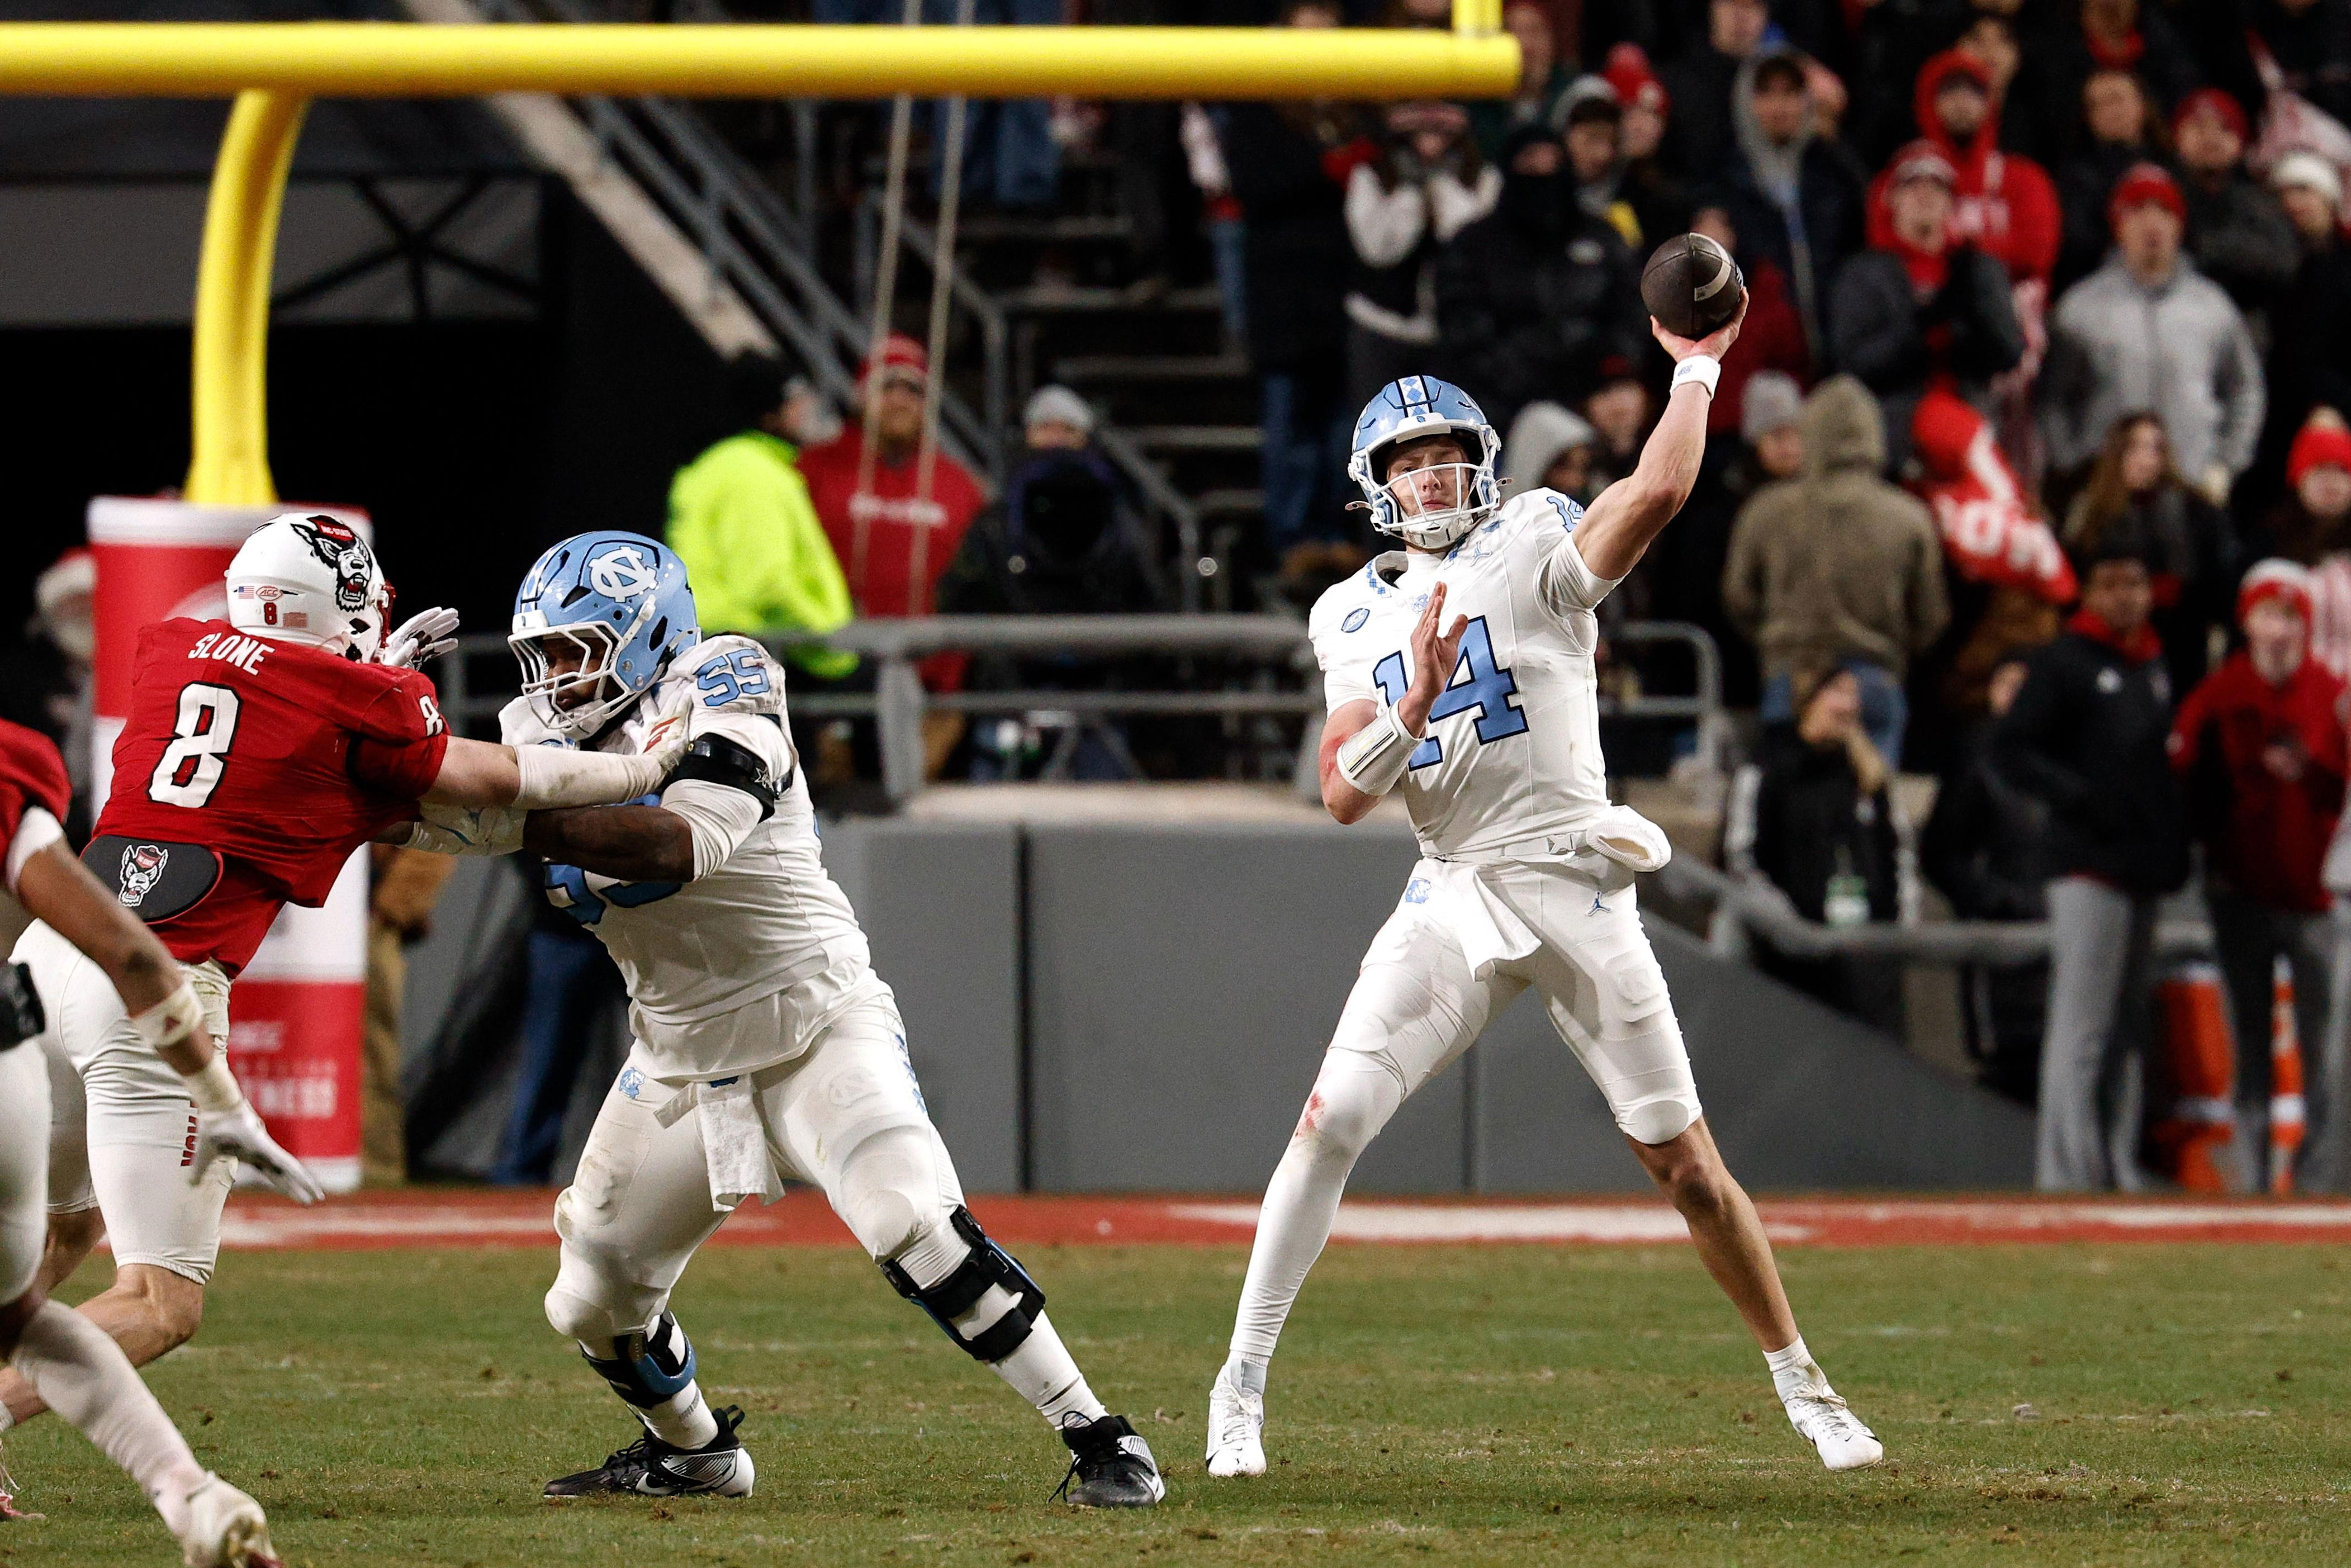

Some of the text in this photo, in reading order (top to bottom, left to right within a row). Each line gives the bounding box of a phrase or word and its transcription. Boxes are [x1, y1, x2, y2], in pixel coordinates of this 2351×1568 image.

[264, 602, 277, 625] 8
[1345, 609, 1367, 630] ACC
[188, 632, 276, 676] SLONE
[693, 648, 770, 707] 55
[1373, 615, 1529, 772] 14
[419, 694, 444, 737] 8
[145, 680, 243, 808] 8
